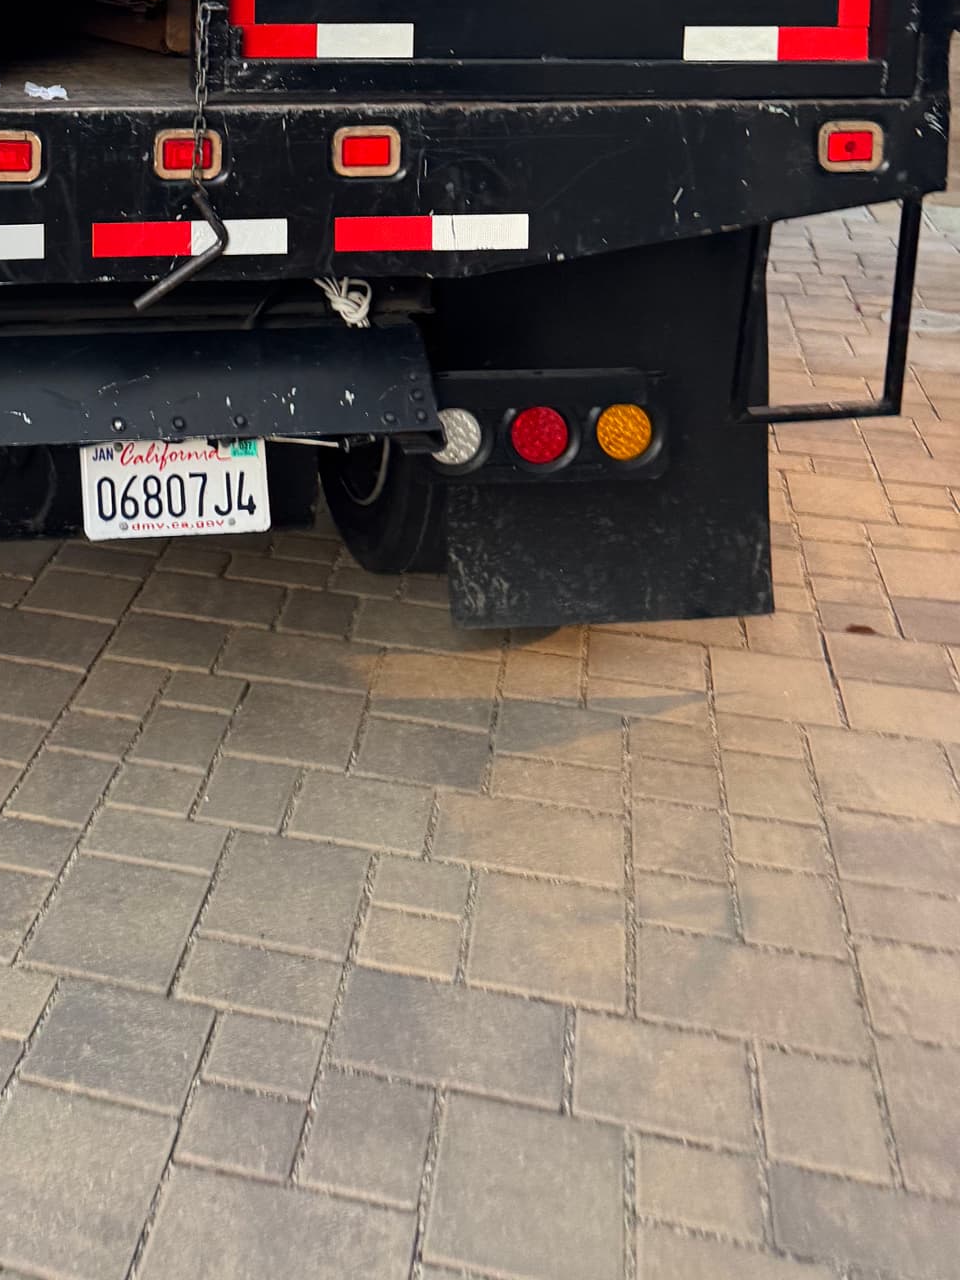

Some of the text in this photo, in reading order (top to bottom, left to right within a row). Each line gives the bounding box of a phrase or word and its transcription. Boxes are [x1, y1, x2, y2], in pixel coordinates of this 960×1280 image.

[92, 447, 114, 462] JAN
[119, 441, 232, 472] California
[96, 471, 257, 522] 06807J4
[131, 519, 225, 532] dmv.ca.gov
